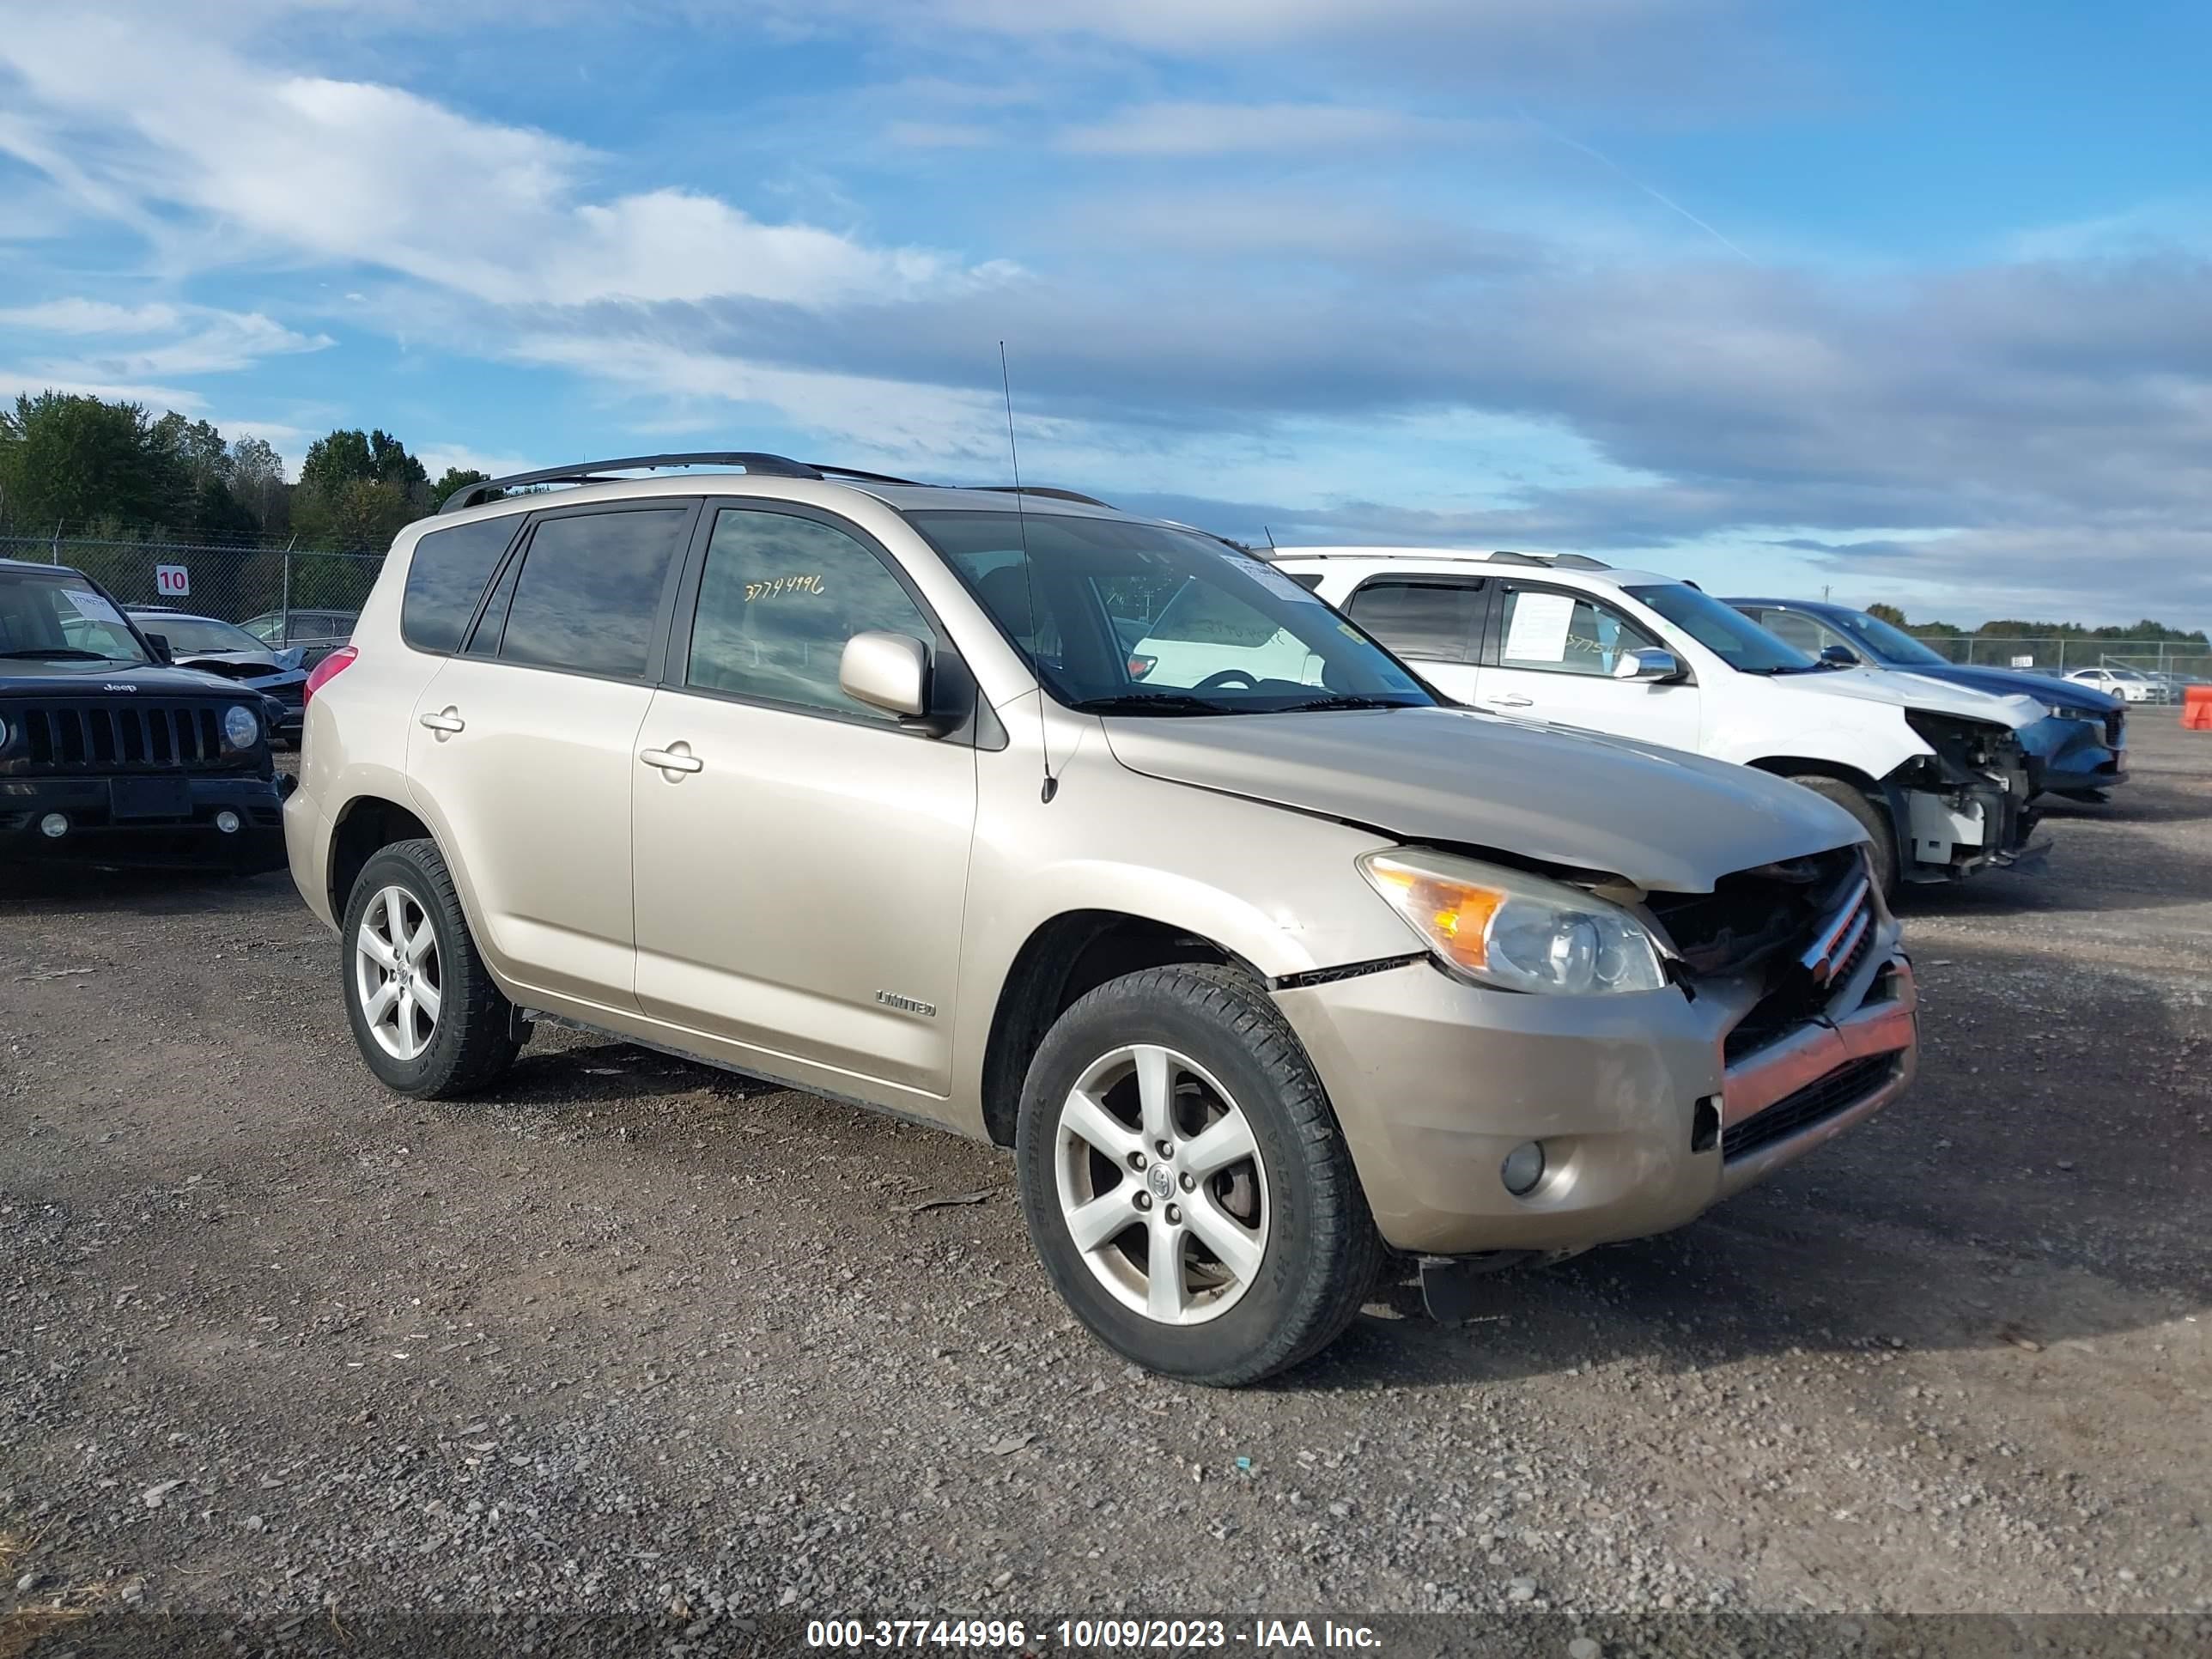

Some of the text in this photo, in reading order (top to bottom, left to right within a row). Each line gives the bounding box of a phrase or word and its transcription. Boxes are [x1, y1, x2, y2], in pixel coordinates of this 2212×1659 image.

[161, 572, 185, 590] 10
[744, 574, 824, 602] 37744996
[103, 684, 137, 693] Jeep
[875, 989, 937, 1018] LIMITED
